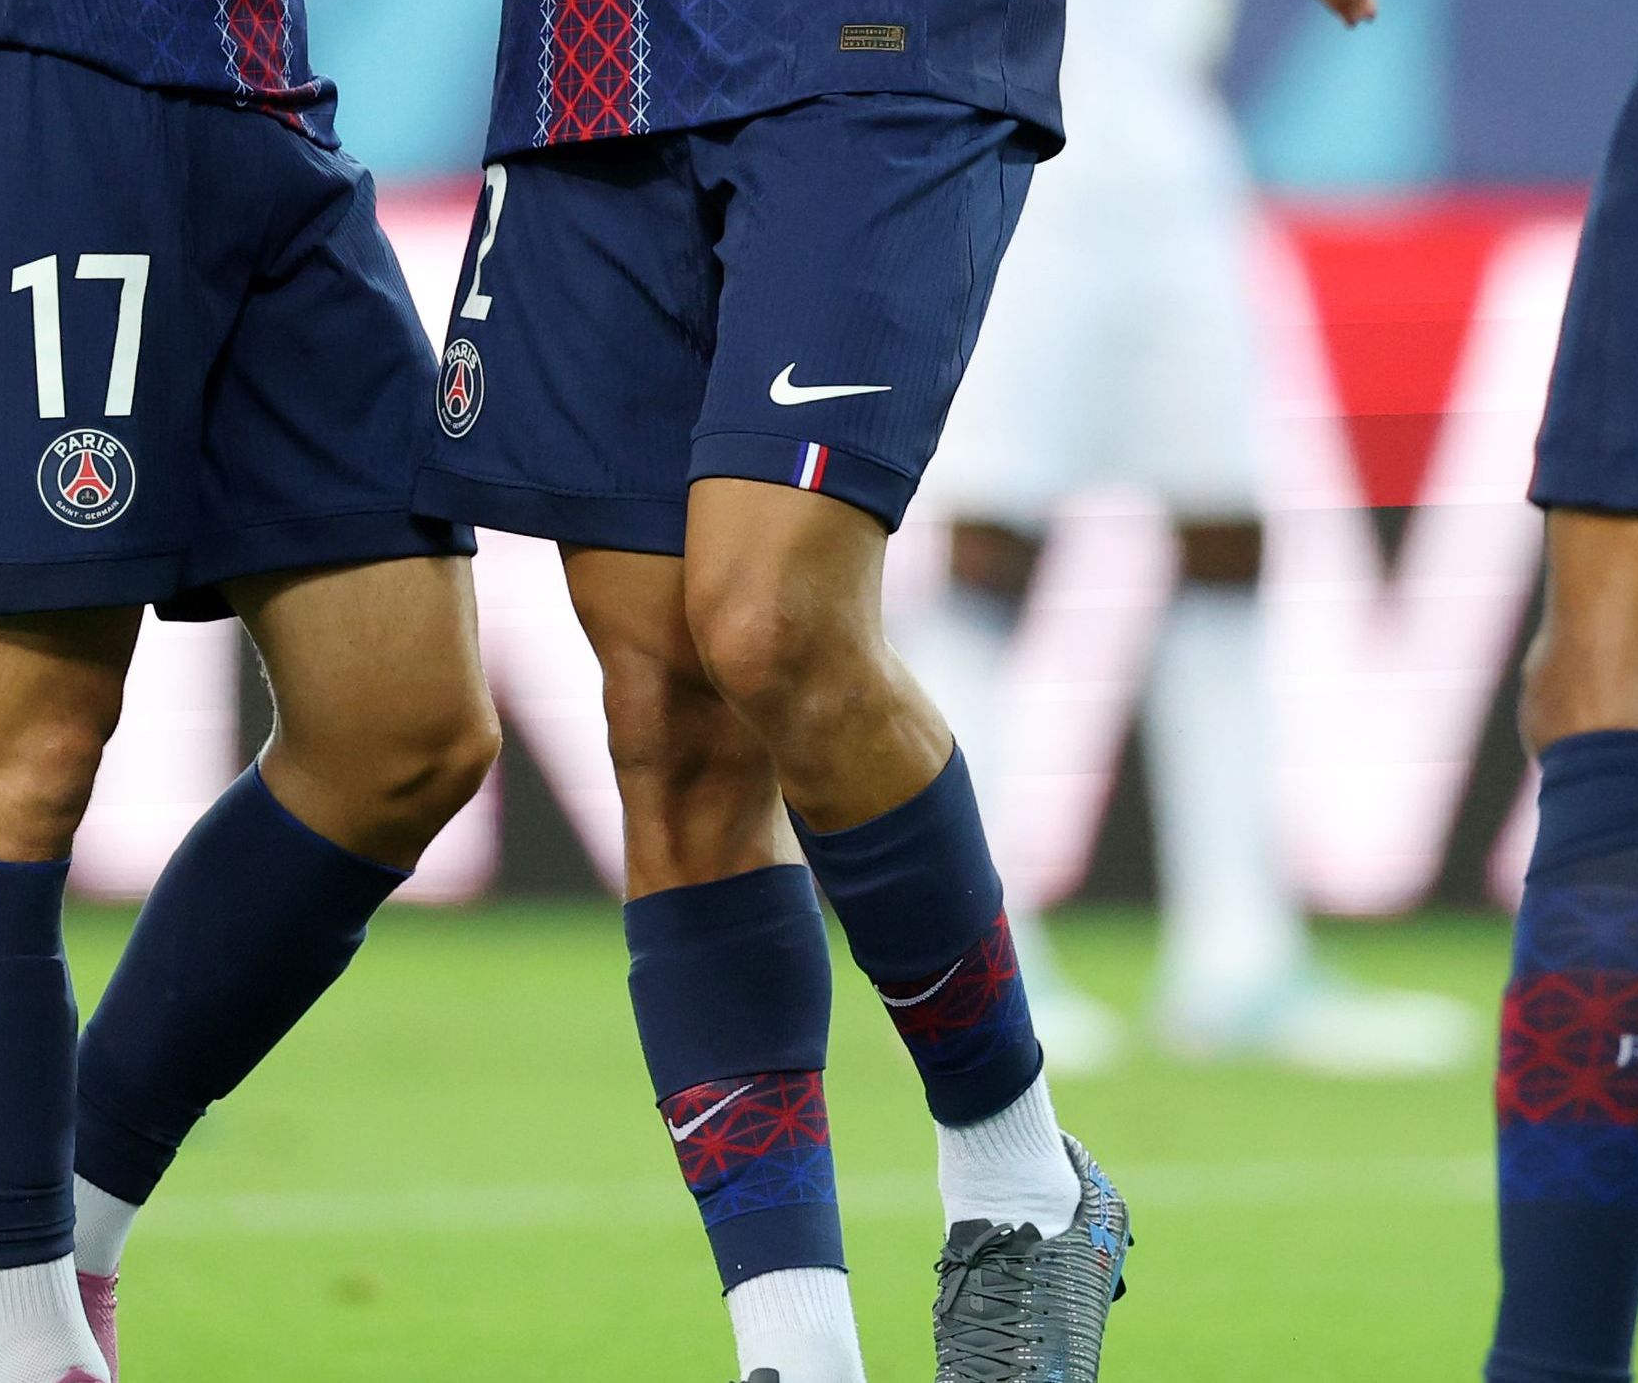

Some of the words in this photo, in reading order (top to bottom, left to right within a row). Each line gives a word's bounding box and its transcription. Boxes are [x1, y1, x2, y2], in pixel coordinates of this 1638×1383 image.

[459, 163, 508, 321] 2
[10, 253, 151, 419] 17
[446, 343, 478, 370] PARIS
[53, 433, 118, 458] PARIS
